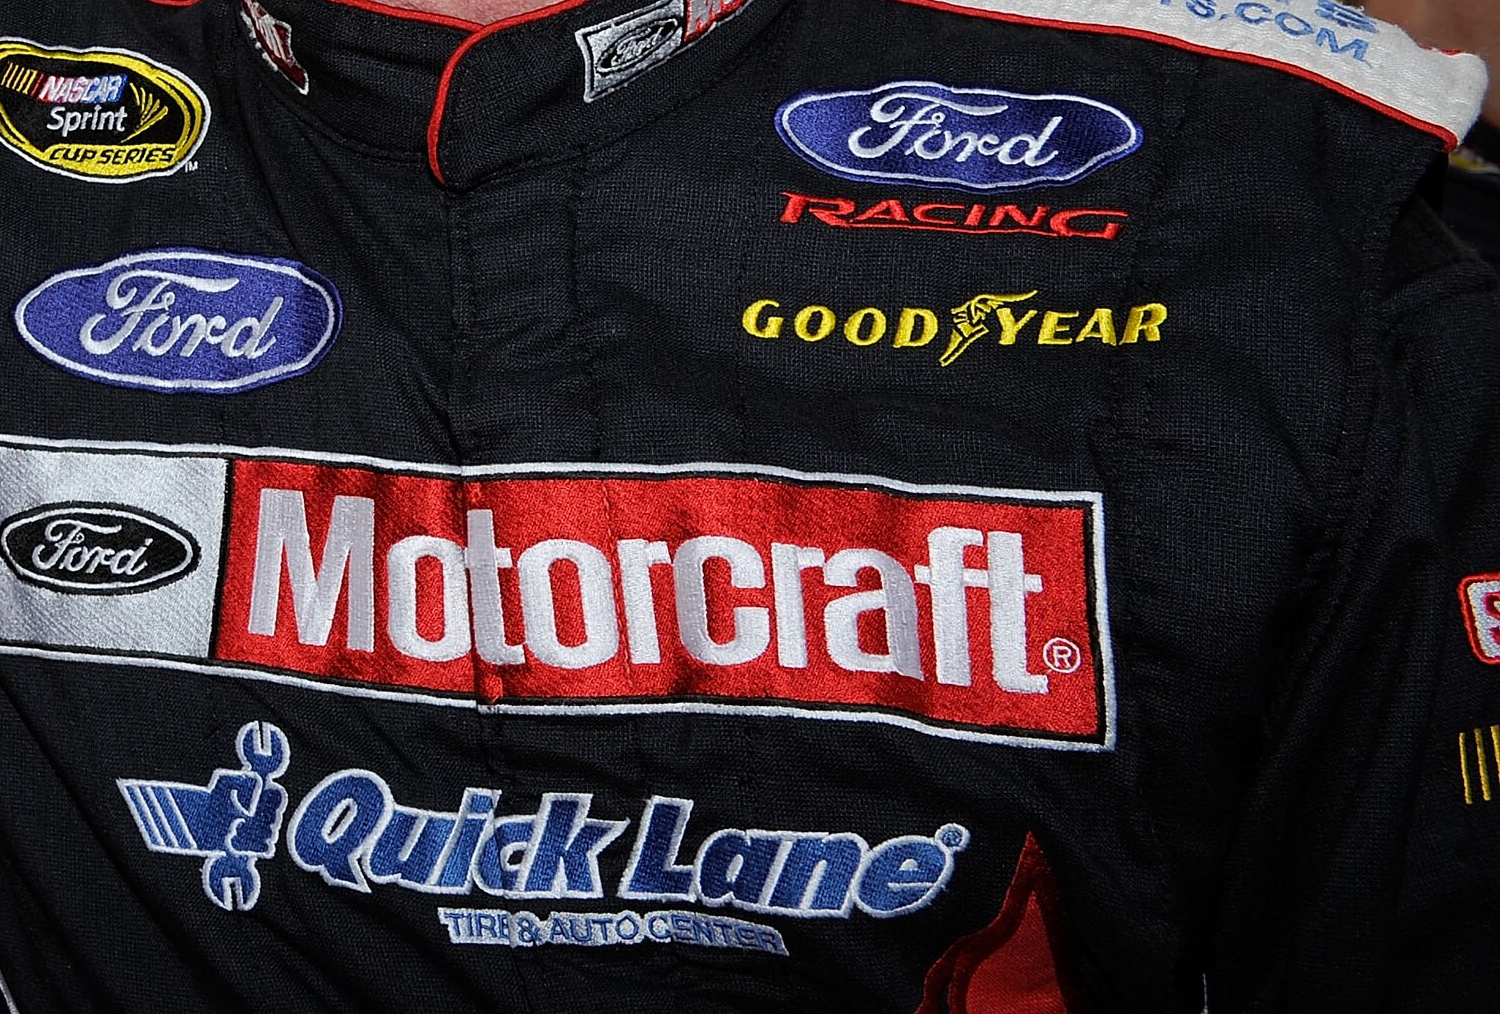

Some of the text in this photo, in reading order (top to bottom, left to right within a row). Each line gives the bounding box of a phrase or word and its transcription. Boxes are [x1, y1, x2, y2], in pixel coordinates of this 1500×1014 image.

[39, 73, 125, 102] NASCAR
[46, 104, 129, 137] Sprint
[847, 92, 1064, 167] Ford
[49, 146, 177, 165] CUP SERIES
[779, 191, 1129, 241] RACING
[79, 268, 285, 360] Ford
[31, 518, 151, 578] Ford
[247, 487, 1050, 695] Motorcraft
[287, 767, 958, 920] Quick Lane
[443, 910, 781, 952] TIRE & AUTO CENTER
